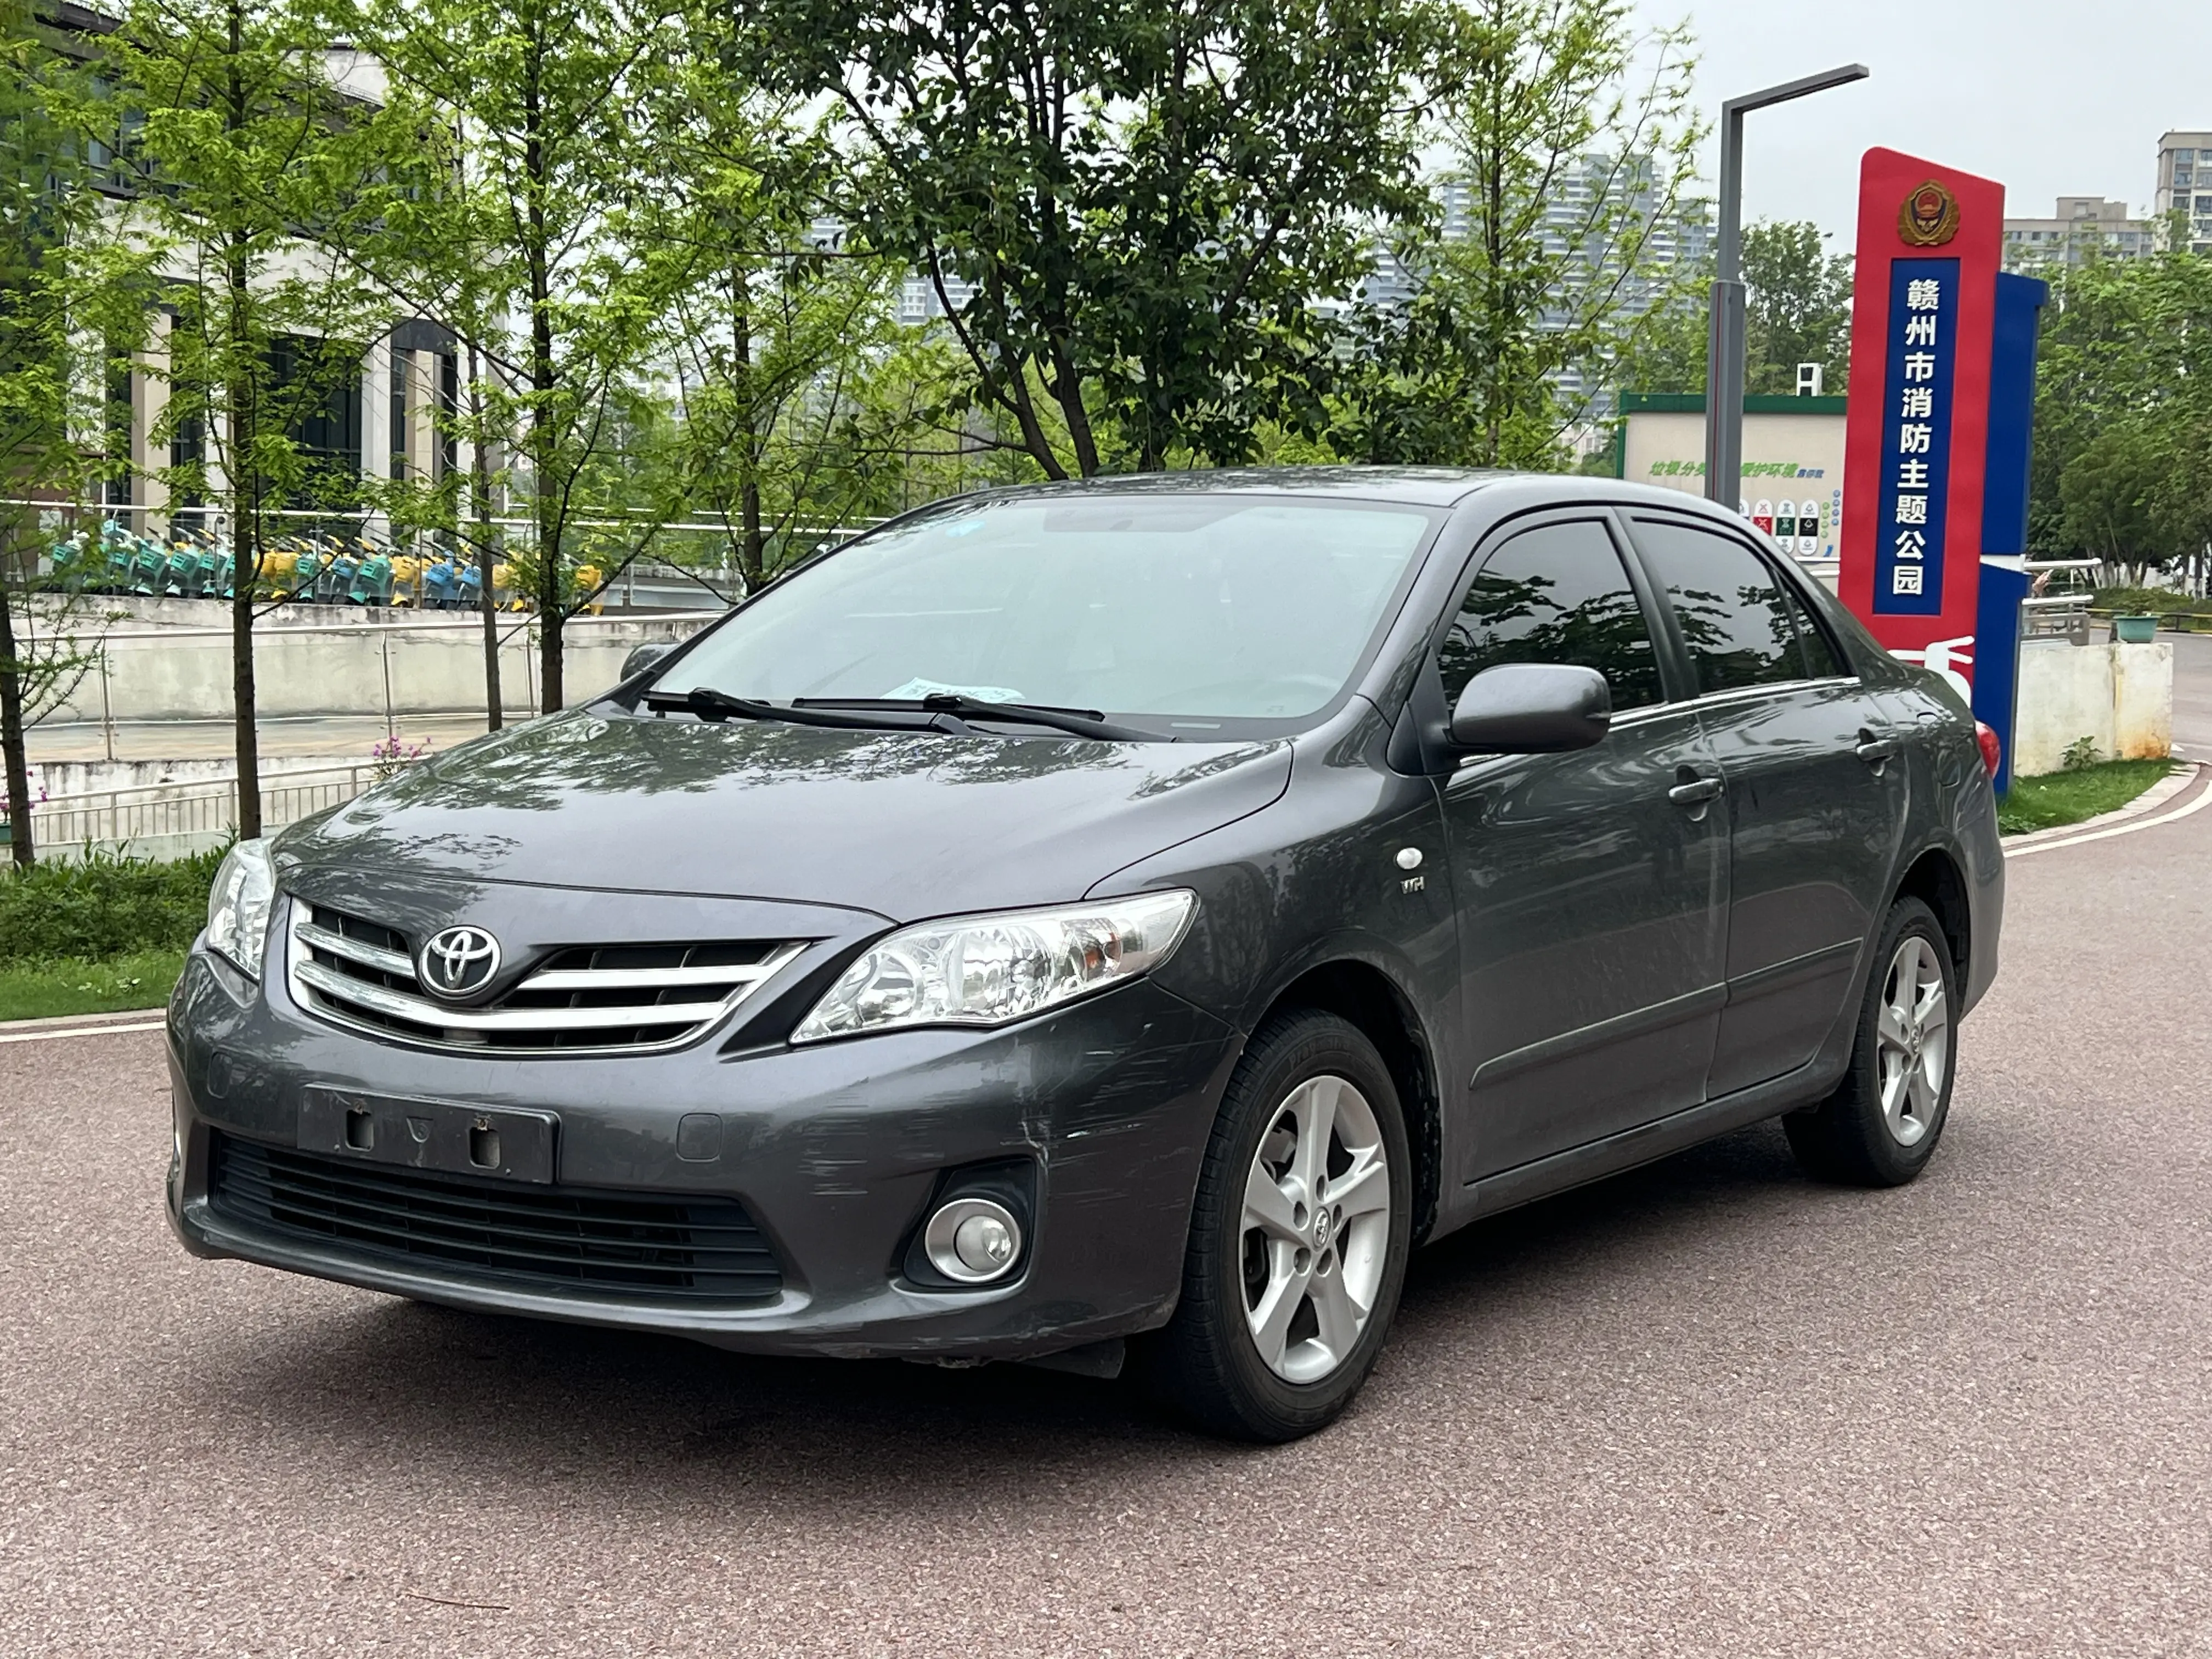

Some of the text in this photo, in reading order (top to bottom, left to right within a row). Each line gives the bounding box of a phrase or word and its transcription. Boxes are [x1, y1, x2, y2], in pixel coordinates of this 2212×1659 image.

[1892, 278, 1940, 595] 赣州市消防主题公园
